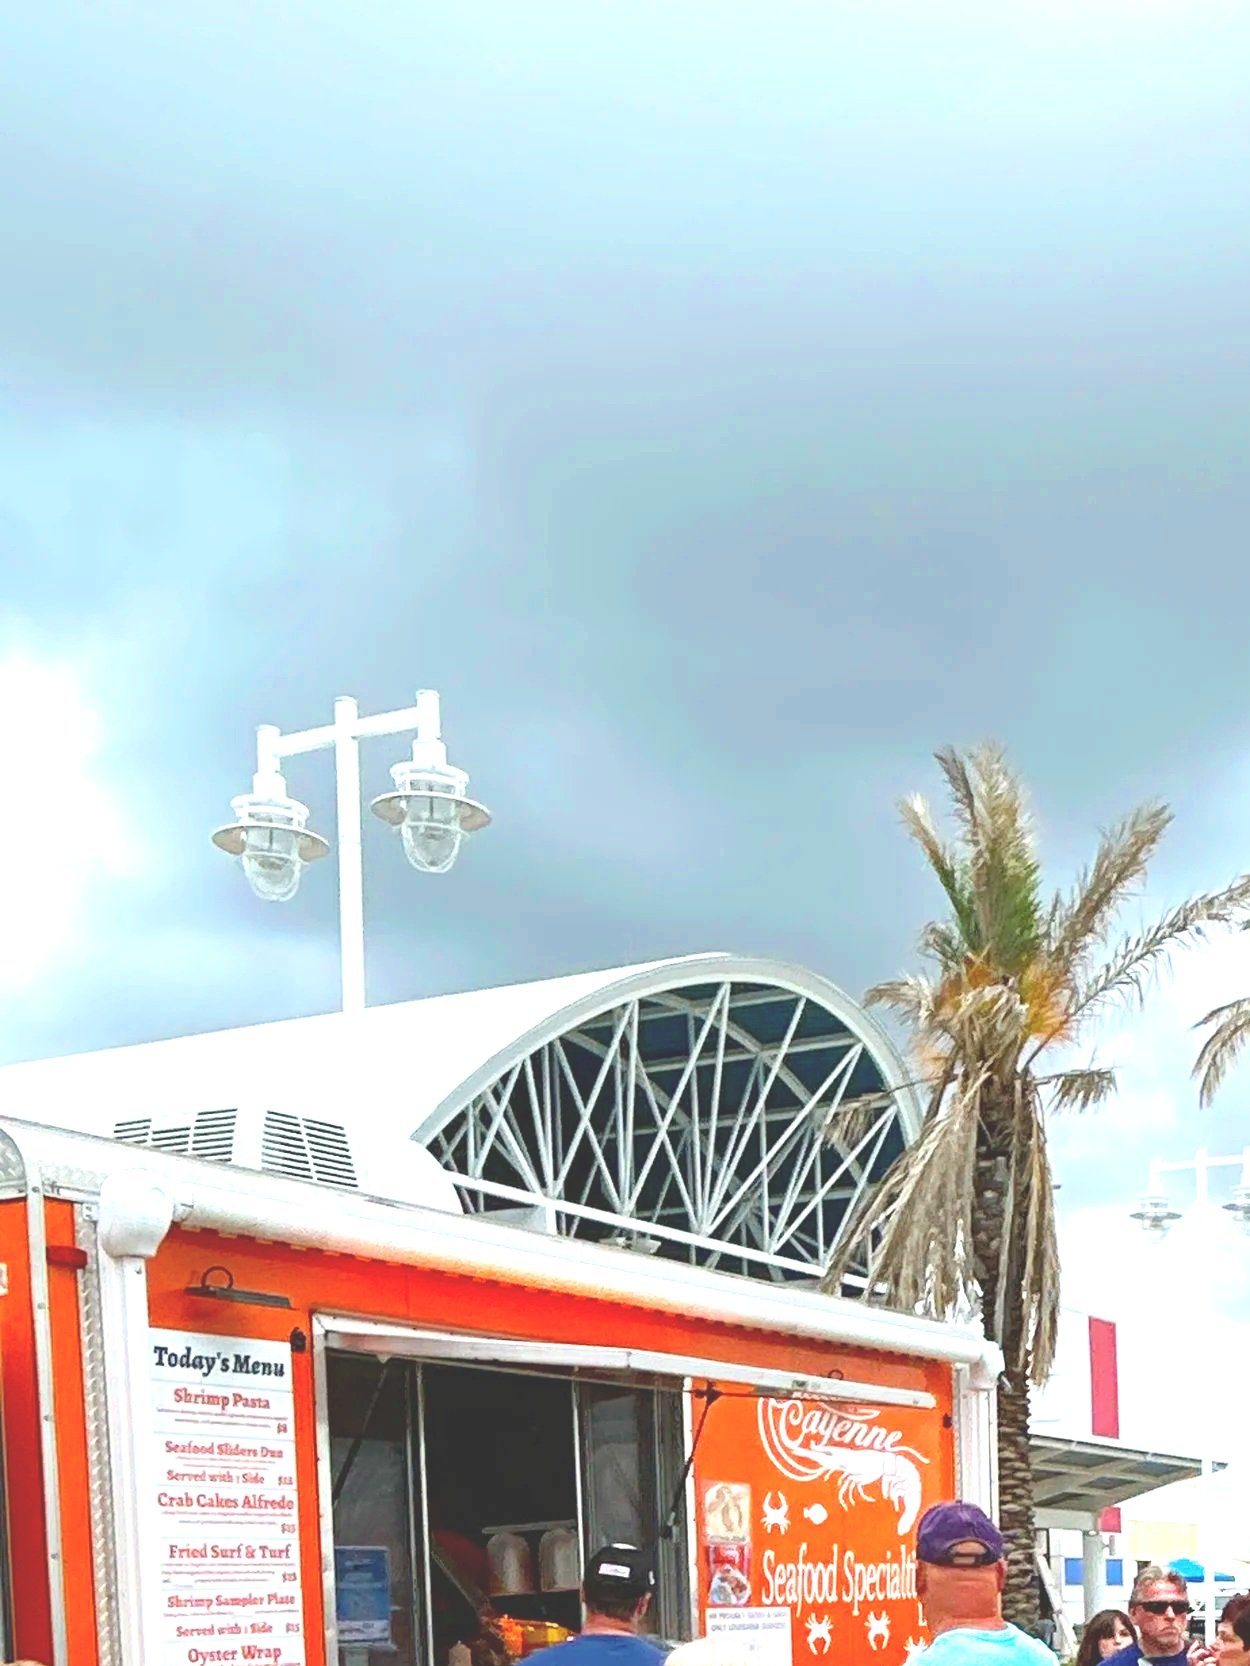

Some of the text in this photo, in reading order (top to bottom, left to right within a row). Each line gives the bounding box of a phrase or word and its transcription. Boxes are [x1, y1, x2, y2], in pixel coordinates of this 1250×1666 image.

[154, 1346, 285, 1377] Today's Menu
[174, 1388, 270, 1411] Shrimp Pasta
[770, 1398, 903, 1450] Cayenne
[165, 1441, 214, 1455] Seafood
[167, 1470, 206, 1481] Served
[208, 1471, 233, 1482] with
[158, 1492, 294, 1509] Crab Cakes Alfredo
[169, 1543, 291, 1558] Fried Surf & Turf
[761, 1543, 917, 1617] Seafood Specialti
[168, 1595, 213, 1609] Shrimp
[216, 1593, 264, 1607] Sampler
[176, 1624, 214, 1637] Served
[188, 1645, 281, 1666] Oyster Wrap
